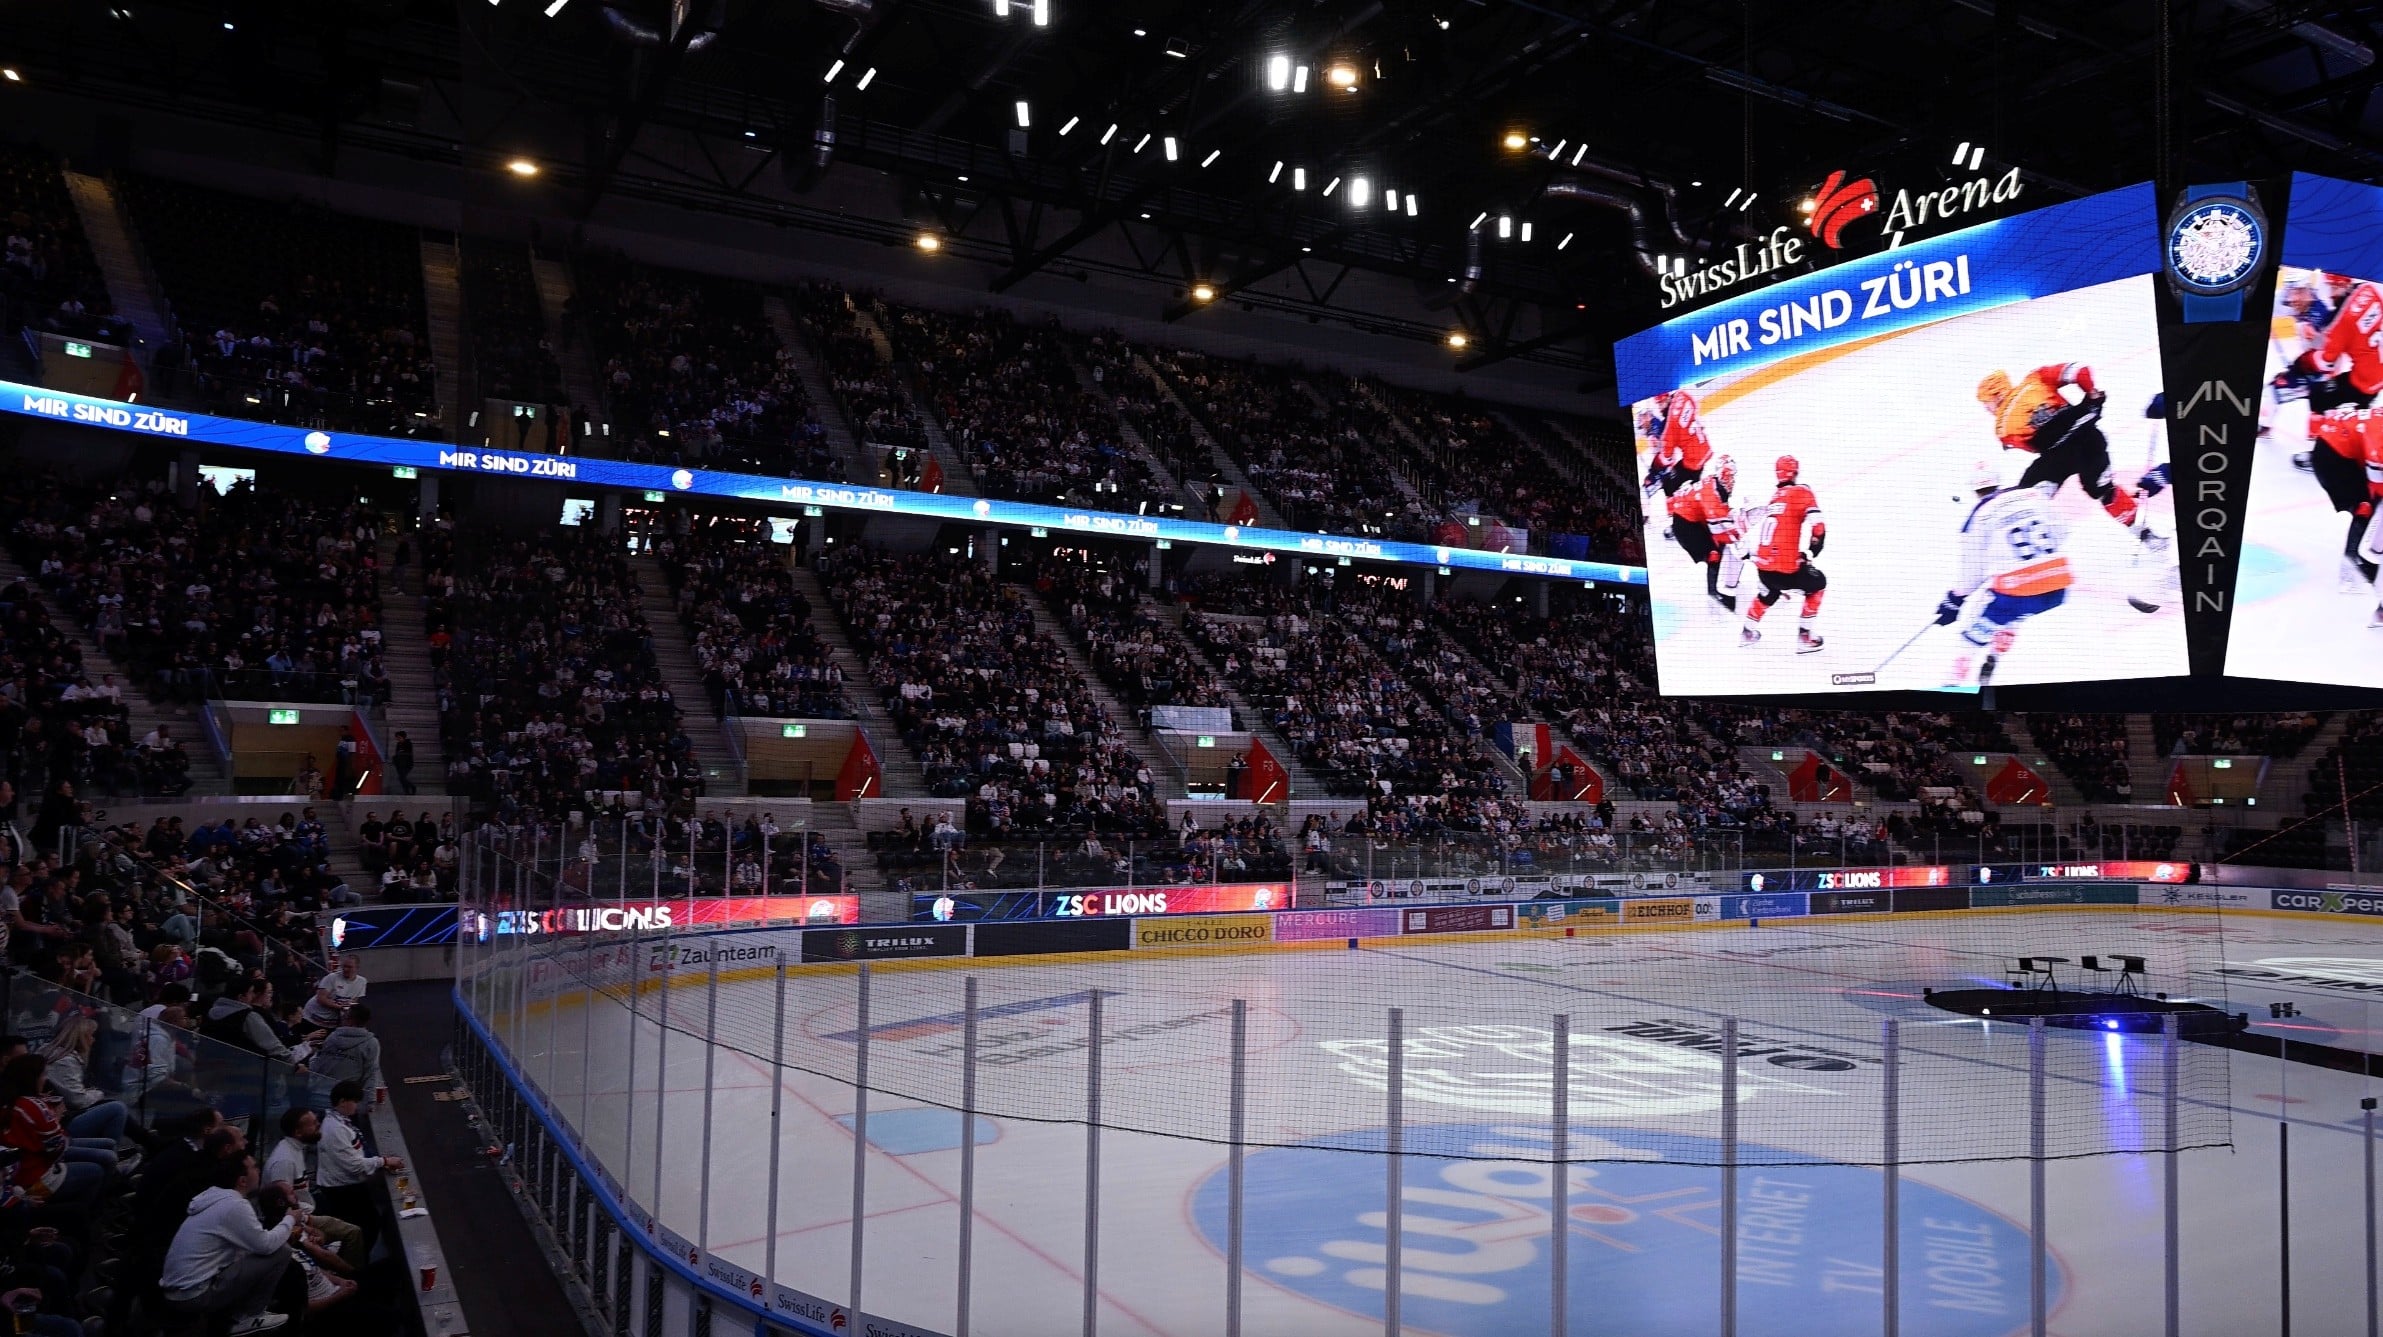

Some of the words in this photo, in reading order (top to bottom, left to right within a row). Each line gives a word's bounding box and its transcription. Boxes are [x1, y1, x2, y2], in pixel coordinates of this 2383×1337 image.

[1659, 225, 1803, 309] SwissLife
[1882, 166, 2025, 235] Arena
[1692, 318, 1753, 366] MIR
[1759, 288, 1853, 345] SIND
[1861, 254, 1971, 320] ZÜRI
[24, 394, 69, 418] MIR
[73, 403, 131, 426] SIND
[133, 411, 188, 435] ZÜRI
[439, 450, 477, 468] MIR
[481, 454, 529, 473] SIND
[531, 458, 576, 478] ZÜRI
[782, 485, 813, 499] MIR
[816, 488, 856, 504] SIND
[857, 490, 895, 508] ZÜRI
[1064, 513, 1090, 527] MIR
[1094, 516, 1126, 531] SIND
[2195, 423, 2229, 613] NORQAIN
[1301, 537, 1324, 550] MIR
[1573, 766, 1585, 776] F2
[1818, 873, 1844, 889] ZSC
[1845, 871, 1881, 888] LIONS
[1056, 894, 1099, 916] ZSC
[1105, 892, 1167, 915] LIONS
[2187, 892, 2249, 901] KESSLER
[1279, 912, 1358, 927] MERCURE
[1638, 904, 1691, 918] EICHHOF
[865, 937, 935, 948] TRILUX
[1141, 928, 1210, 944] CHICCO
[1215, 925, 1266, 940] D'ORO
[681, 945, 777, 966] Zaunteam
[1732, 1176, 1813, 1287] INTERNET
[1923, 1216, 2008, 1315] MOBILE
[708, 1262, 747, 1293] SwissLife
[777, 1293, 826, 1324] SwissLife
